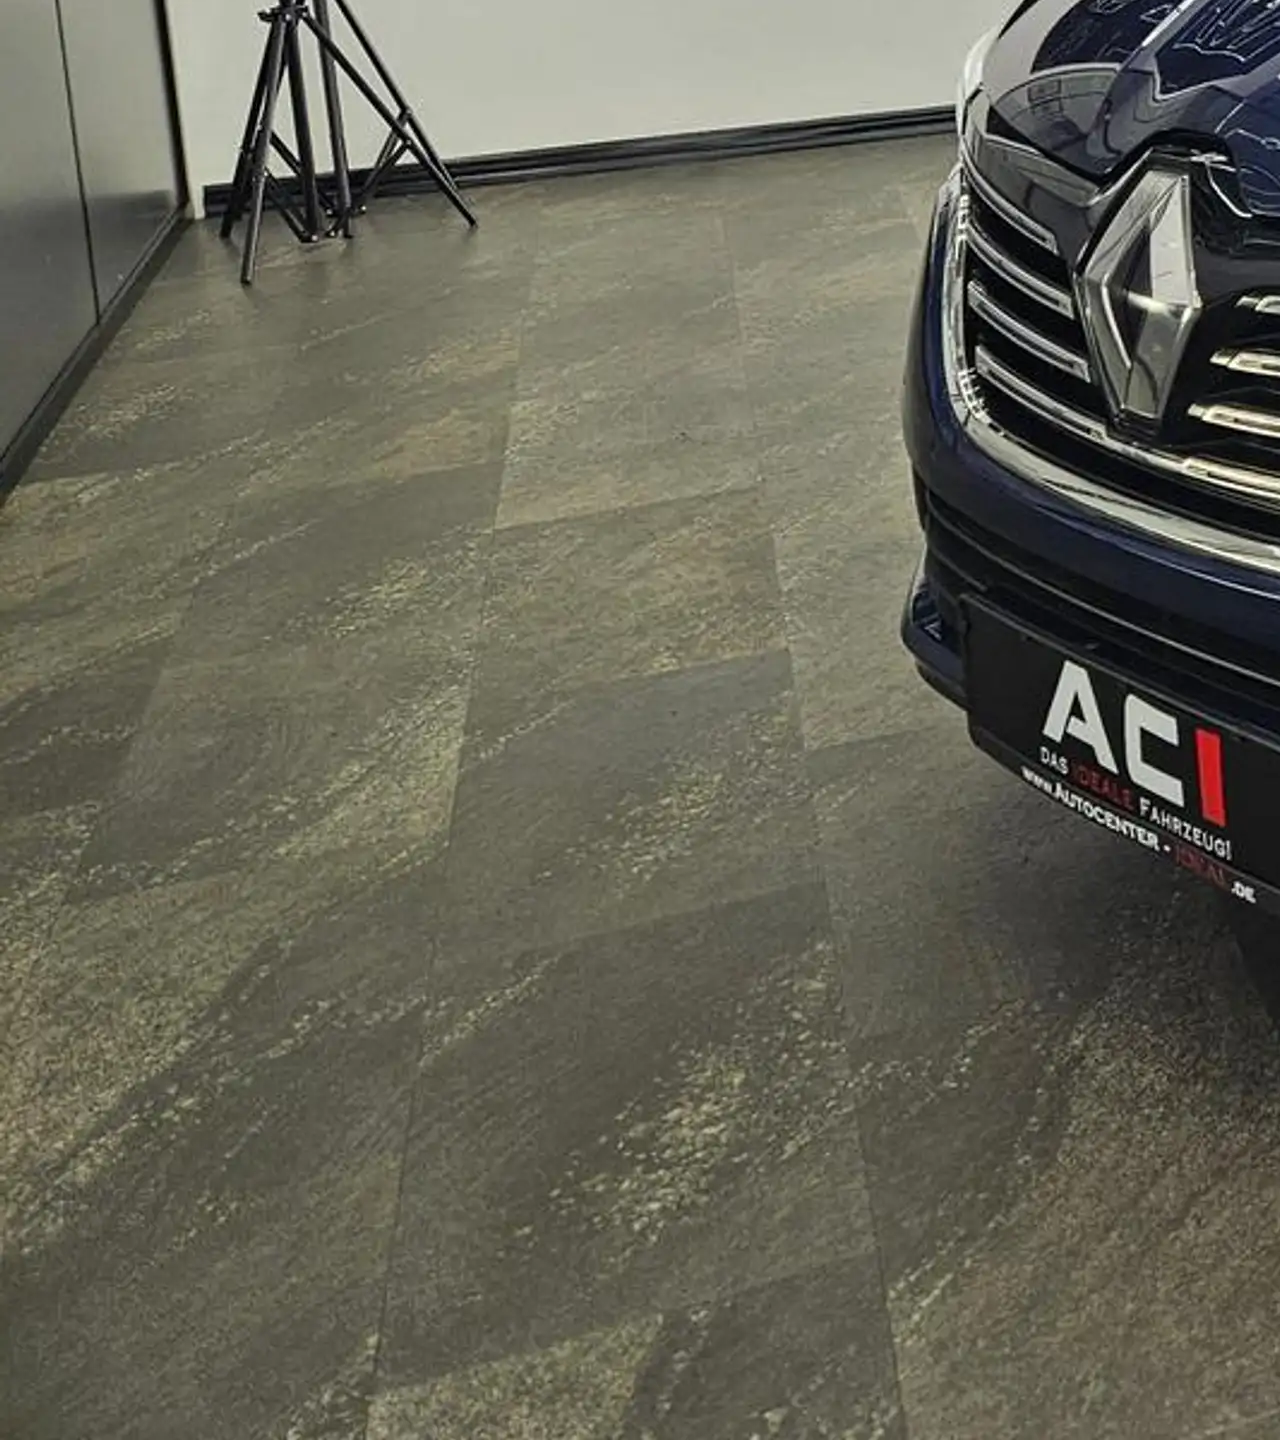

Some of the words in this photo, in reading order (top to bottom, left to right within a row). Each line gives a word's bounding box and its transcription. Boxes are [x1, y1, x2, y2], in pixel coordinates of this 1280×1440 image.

[1040, 747, 1068, 774] DAS
[1139, 796, 1233, 861] FAHRZEUG!
[1042, 659, 1227, 828] ACI
